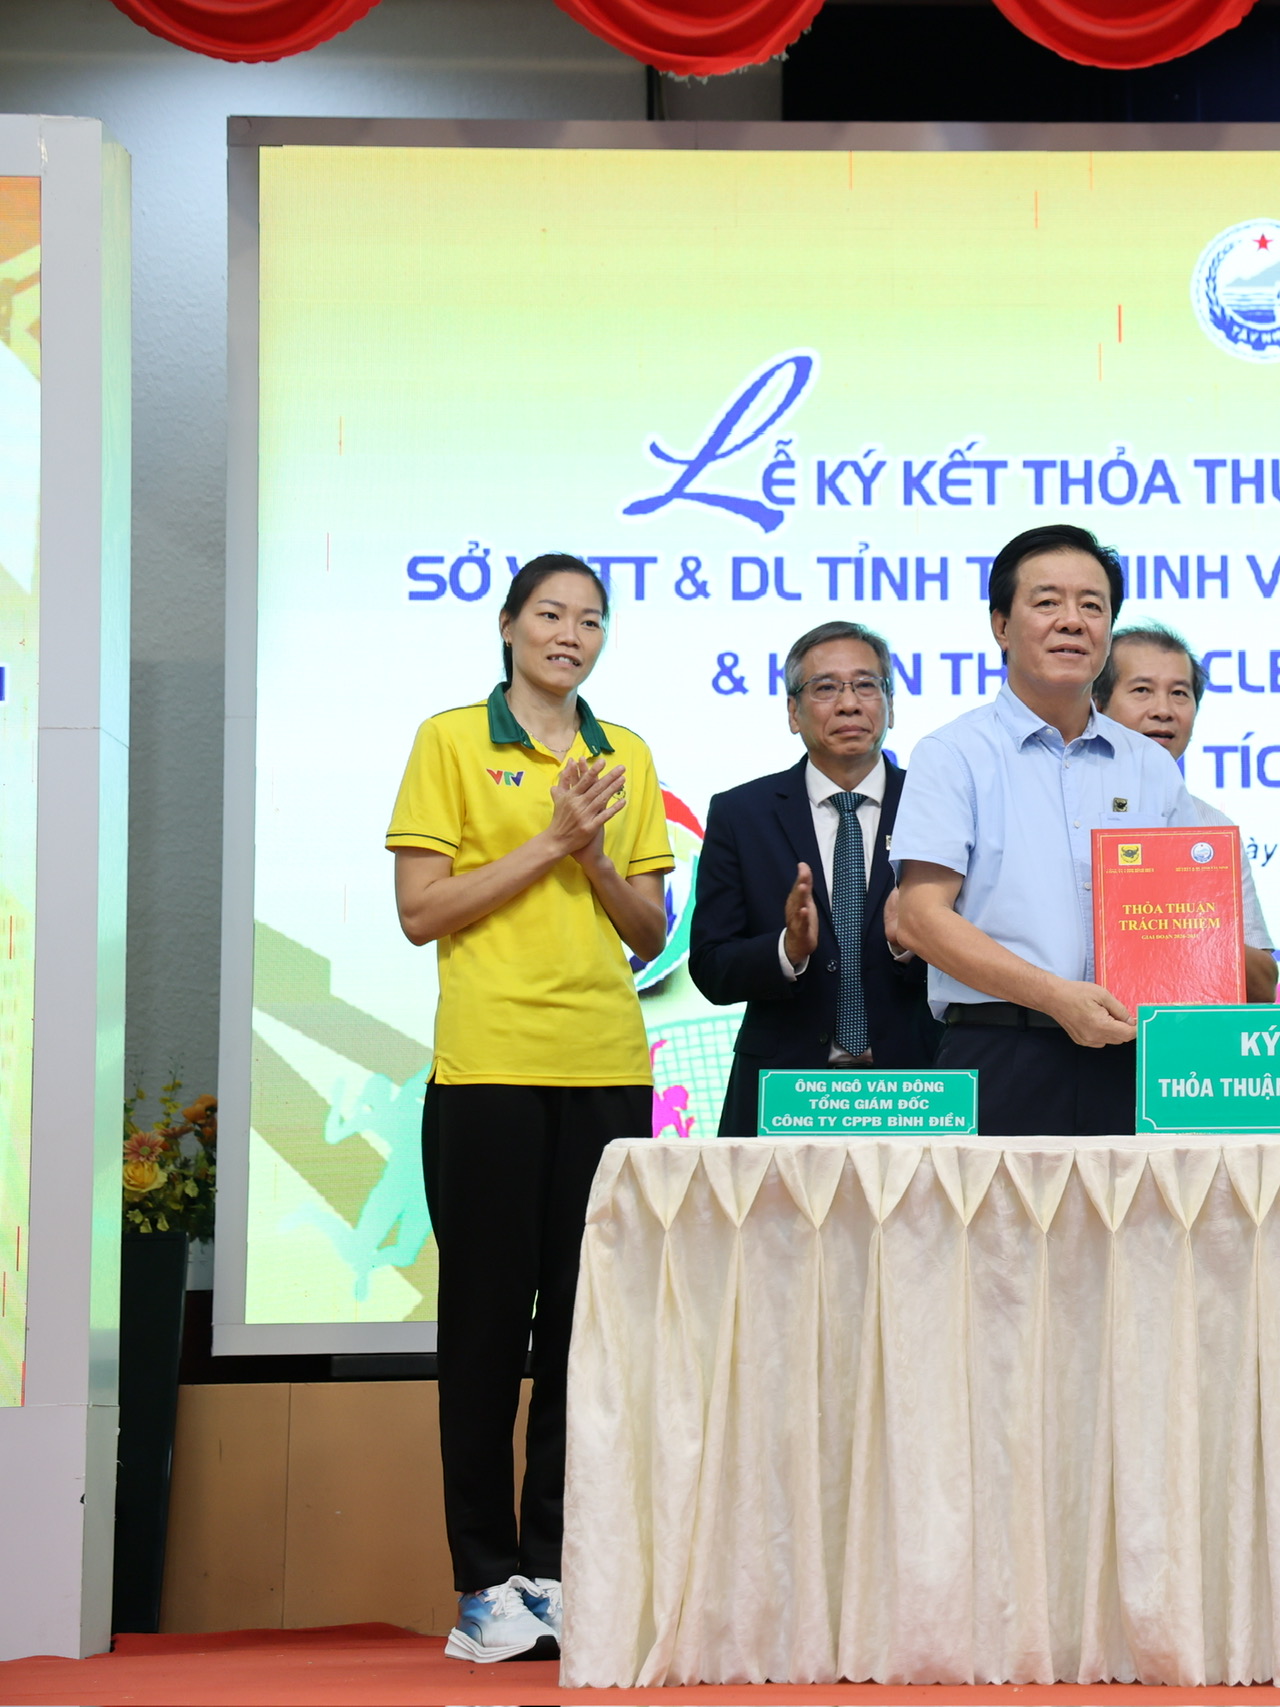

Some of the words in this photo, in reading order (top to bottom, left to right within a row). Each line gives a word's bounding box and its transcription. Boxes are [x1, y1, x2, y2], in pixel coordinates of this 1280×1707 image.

[818, 450, 886, 505] KÝ
[904, 442, 1007, 505] KẾT
[1024, 447, 1180, 505] THỎA
[407, 542, 490, 601] SỞ
[675, 557, 710, 600] &
[732, 557, 801, 600] DL
[817, 543, 947, 600] TỈNH
[1120, 556, 1228, 600] INH
[712, 653, 748, 695] &
[486, 768, 524, 787] VTV
[1122, 901, 1163, 915] THỎA
[1165, 901, 1216, 916] THUẬN
[1118, 917, 1168, 931] TRÁCH
[1172, 917, 1221, 932] NHIỆM
[1241, 1025, 1280, 1056] KÝ
[795, 1079, 826, 1092] ÔNG
[832, 1079, 862, 1092] NGÔ
[867, 1080, 897, 1092] VĂN
[902, 1079, 944, 1092] ĐÔNG
[1158, 1072, 1214, 1097] THỎA
[809, 1094, 849, 1109] TỔNG
[855, 1097, 892, 1109] GIÁM
[898, 1096, 929, 1109] ĐỐC
[772, 1114, 813, 1126] CÔNG
[818, 1117, 837, 1126] TY
[842, 1117, 882, 1126] CPPB
[888, 1114, 923, 1126] BÌNH
[929, 1113, 965, 1126] ĐIỀN
